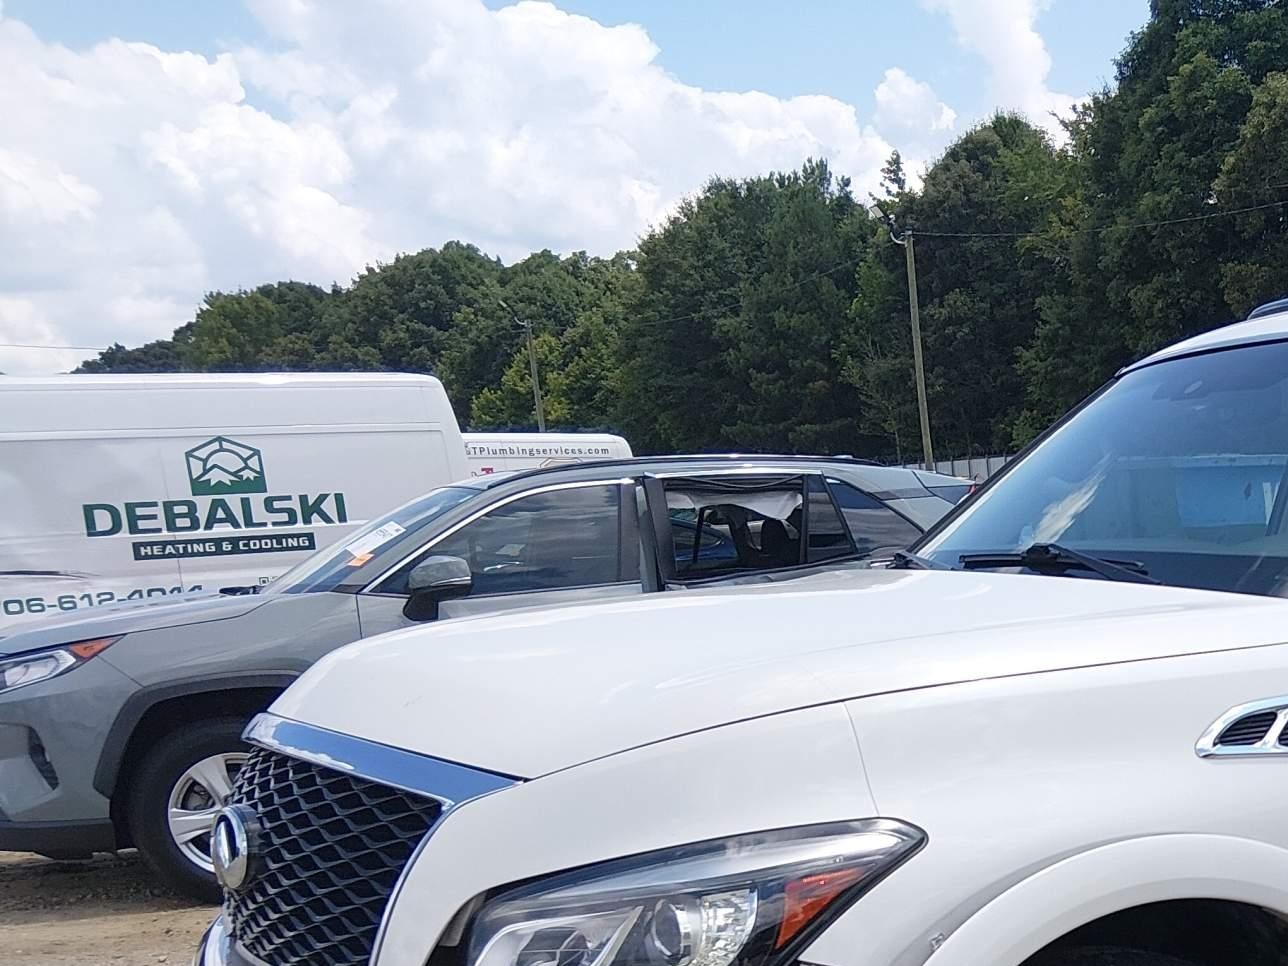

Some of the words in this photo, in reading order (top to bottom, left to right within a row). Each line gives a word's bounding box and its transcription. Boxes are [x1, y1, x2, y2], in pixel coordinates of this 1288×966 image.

[82, 493, 348, 537] DEBALSKI
[140, 543, 216, 556] HEATING
[222, 541, 232, 551] &
[239, 536, 309, 551] COOLING
